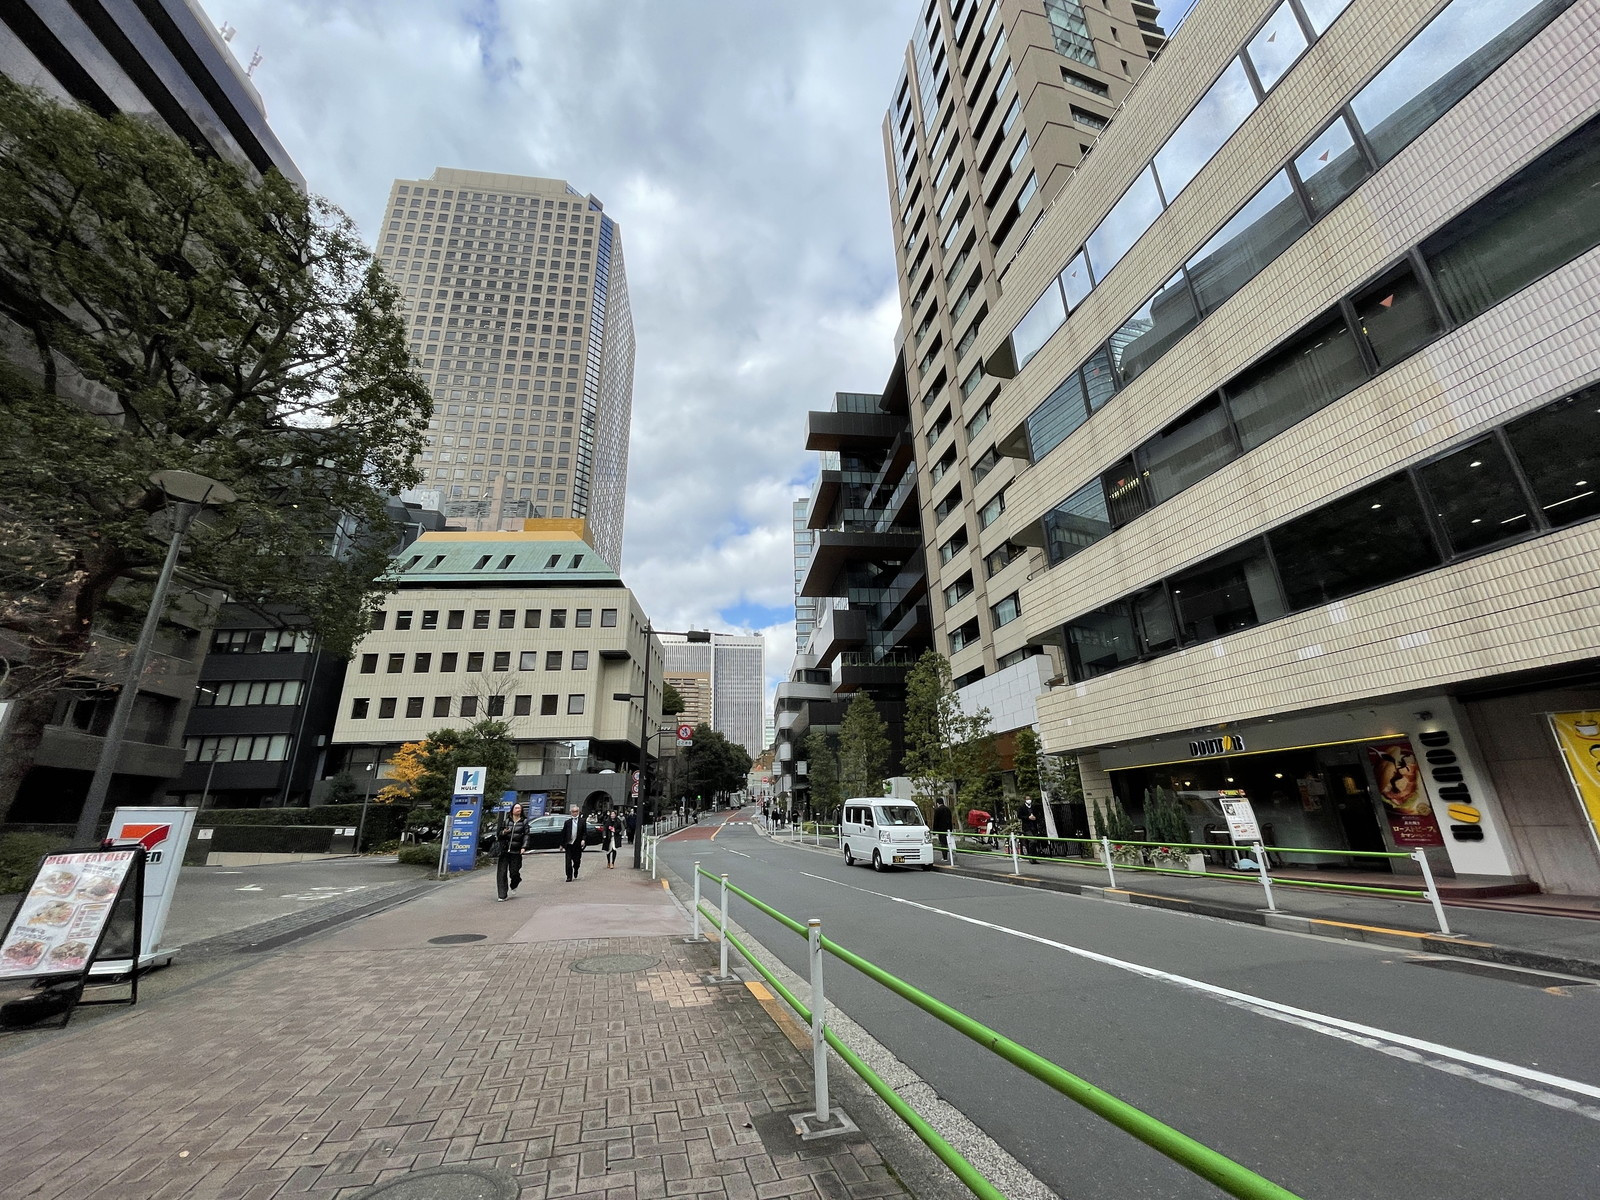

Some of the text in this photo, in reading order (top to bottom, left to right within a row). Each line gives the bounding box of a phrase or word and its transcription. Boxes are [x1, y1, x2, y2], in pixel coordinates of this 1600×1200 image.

[45, 851, 133, 865] MEAT MEAT MEET
